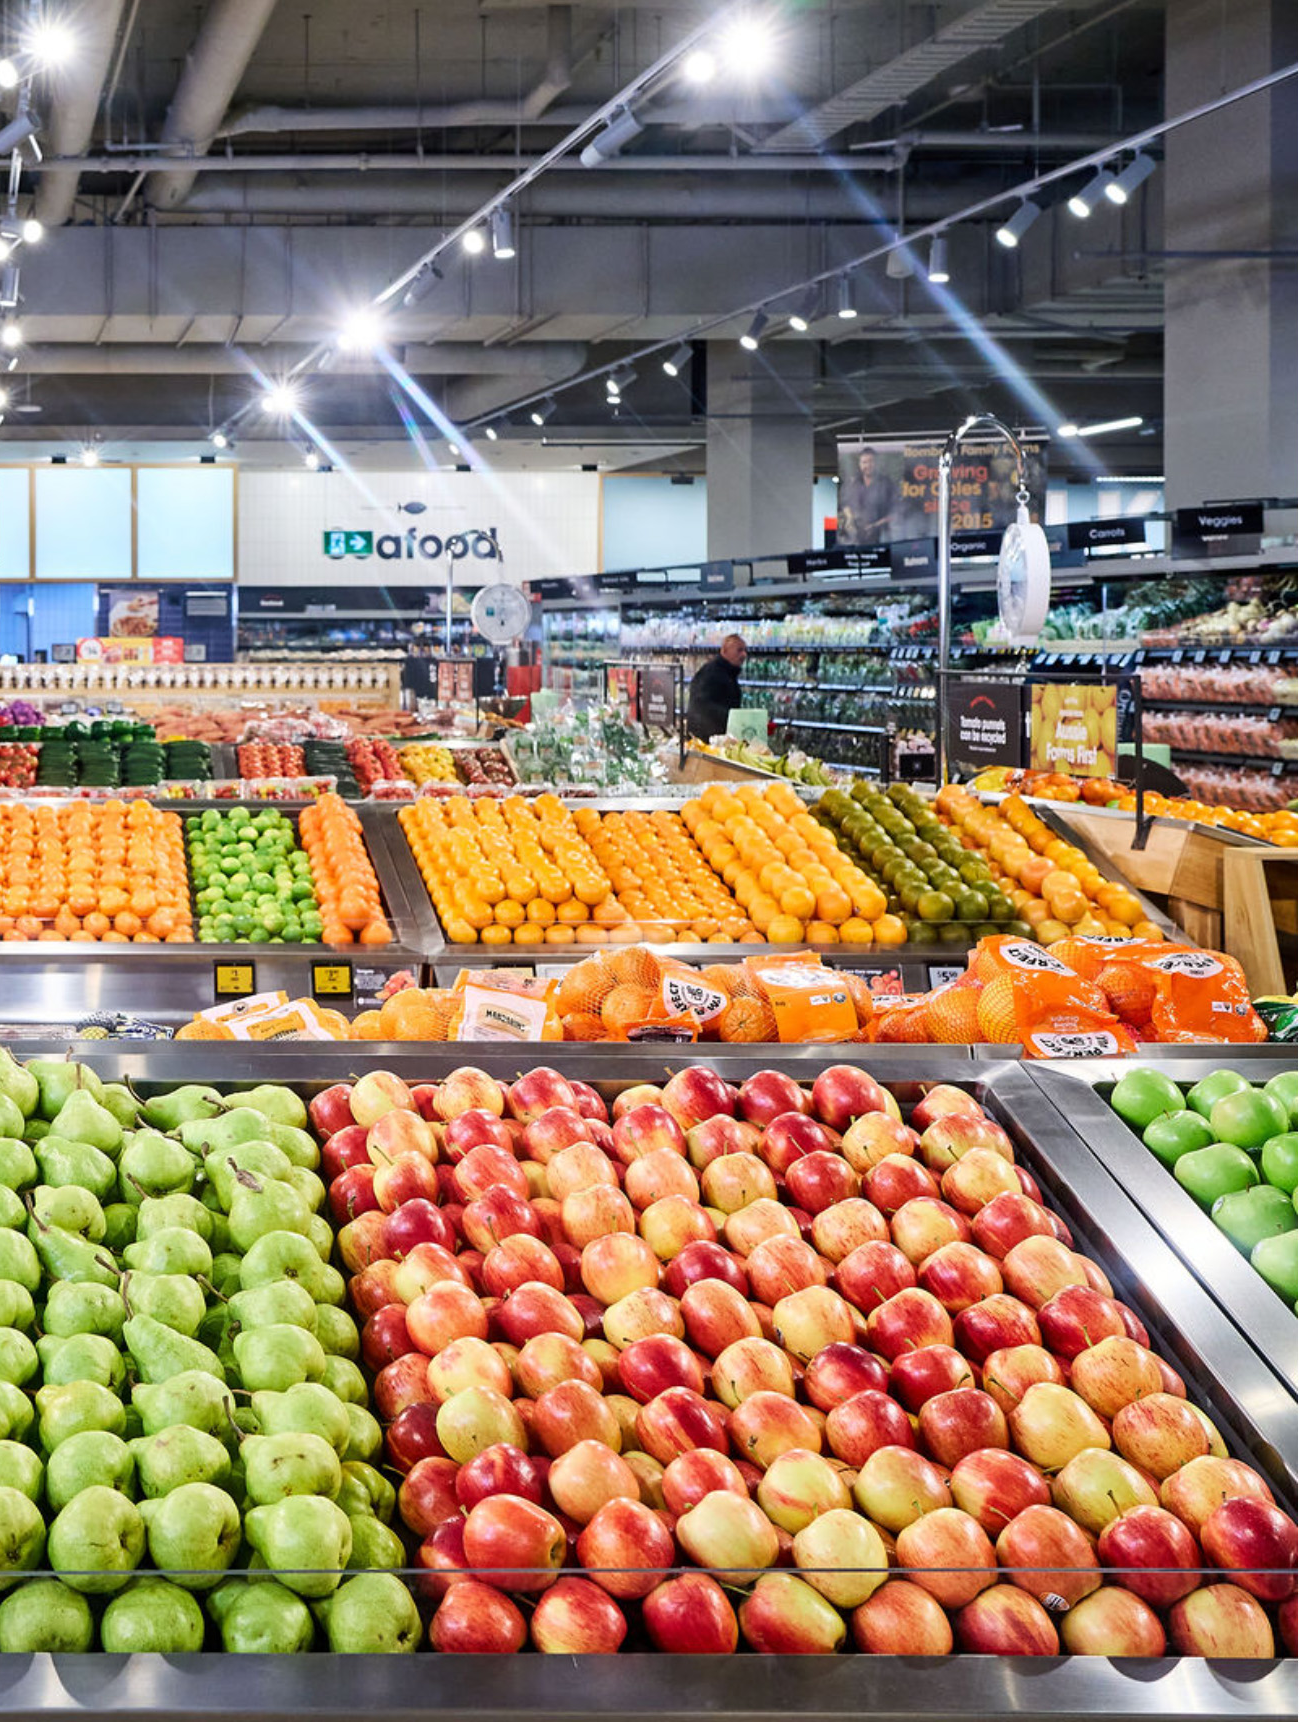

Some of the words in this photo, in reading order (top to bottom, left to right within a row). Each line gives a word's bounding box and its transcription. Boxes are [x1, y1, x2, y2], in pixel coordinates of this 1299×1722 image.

[902, 481, 926, 497] for
[923, 499, 971, 513] sice
[952, 513, 994, 529] 2015
[1199, 515, 1243, 527] Veggies
[1089, 528, 1125, 539] Carrots
[327, 527, 497, 560] afood
[951, 542, 987, 553] Organic
[1055, 721, 1088, 740] Aussie
[1077, 745, 1097, 765] First
